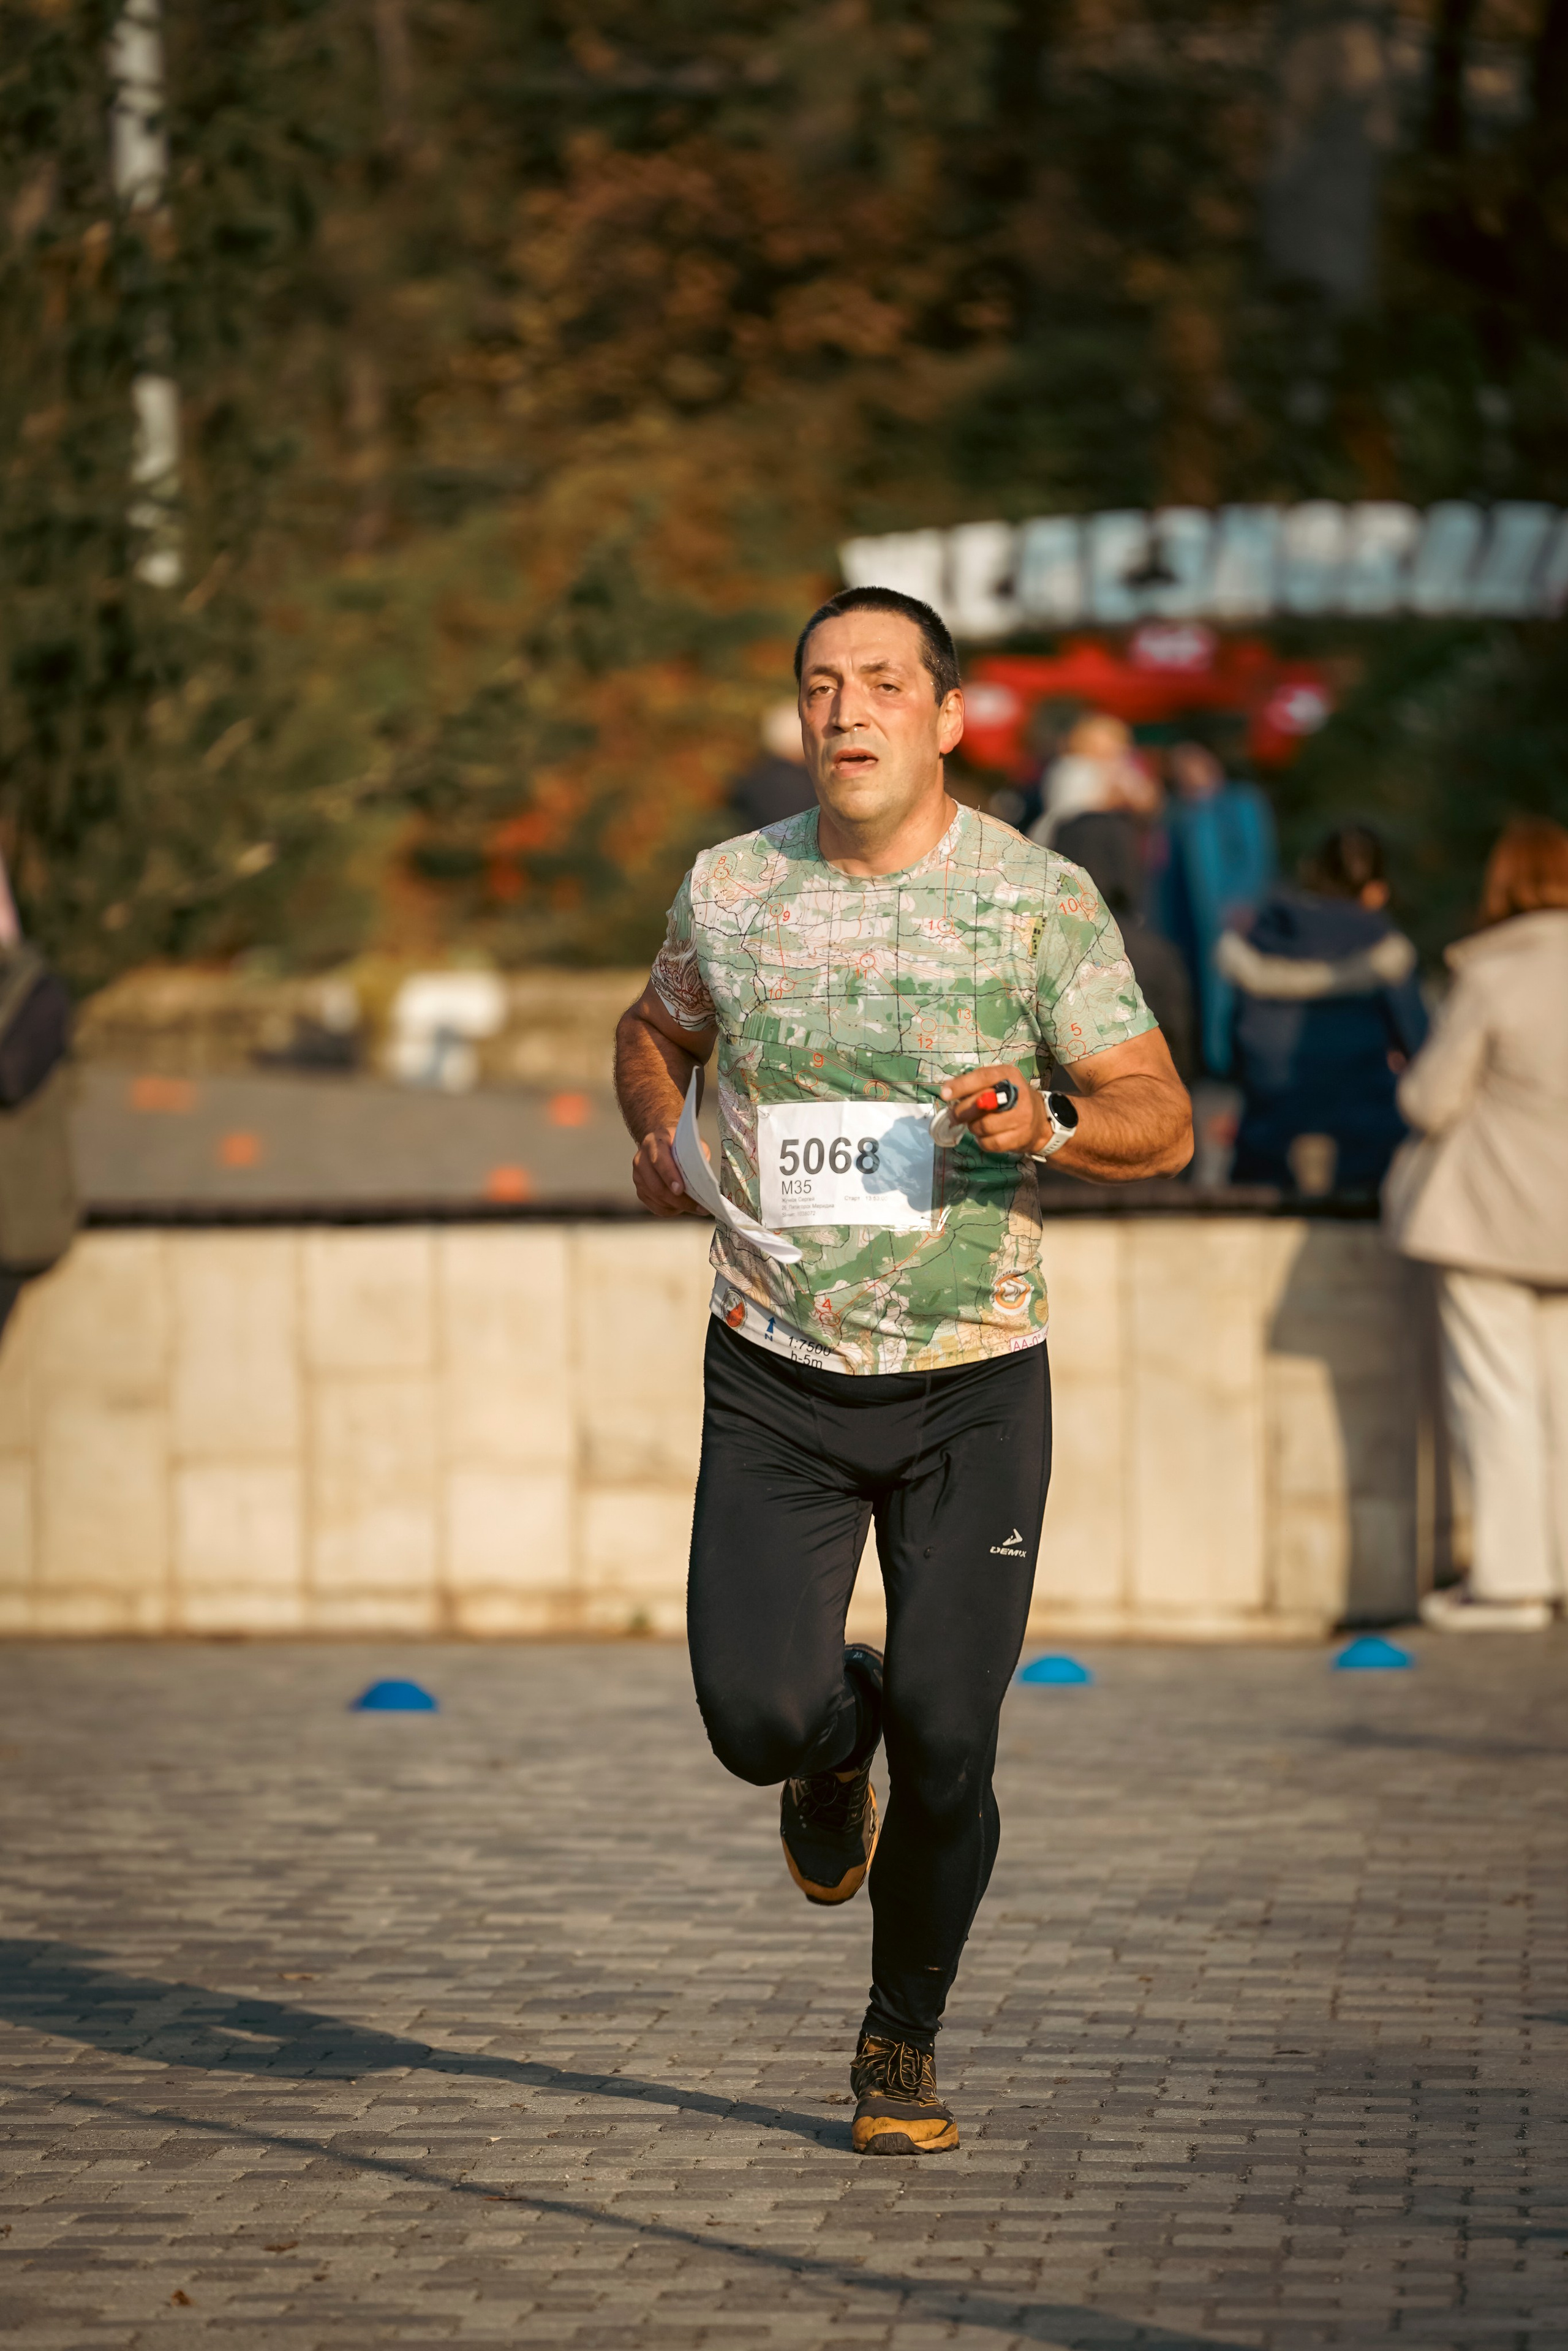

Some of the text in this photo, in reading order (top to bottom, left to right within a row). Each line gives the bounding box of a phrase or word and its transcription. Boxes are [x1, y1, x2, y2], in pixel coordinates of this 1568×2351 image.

[718, 856, 726, 864] 8
[1059, 897, 1079, 916] 10
[783, 911, 790, 921] 9
[928, 919, 934, 930] 1
[854, 968, 868, 980] 11
[767, 988, 783, 1000] 10
[957, 1008, 971, 1019] 13
[1070, 1022, 1082, 1036] 5
[918, 1037, 933, 1049] 12
[813, 1053, 823, 1068] 9
[778, 1136, 881, 1176] 5068
[781, 1180, 812, 1195] M35
[822, 1299, 832, 1310] 4
[788, 1335, 832, 1357] 1:7500
[990, 1546, 1027, 1558] DEMIX
